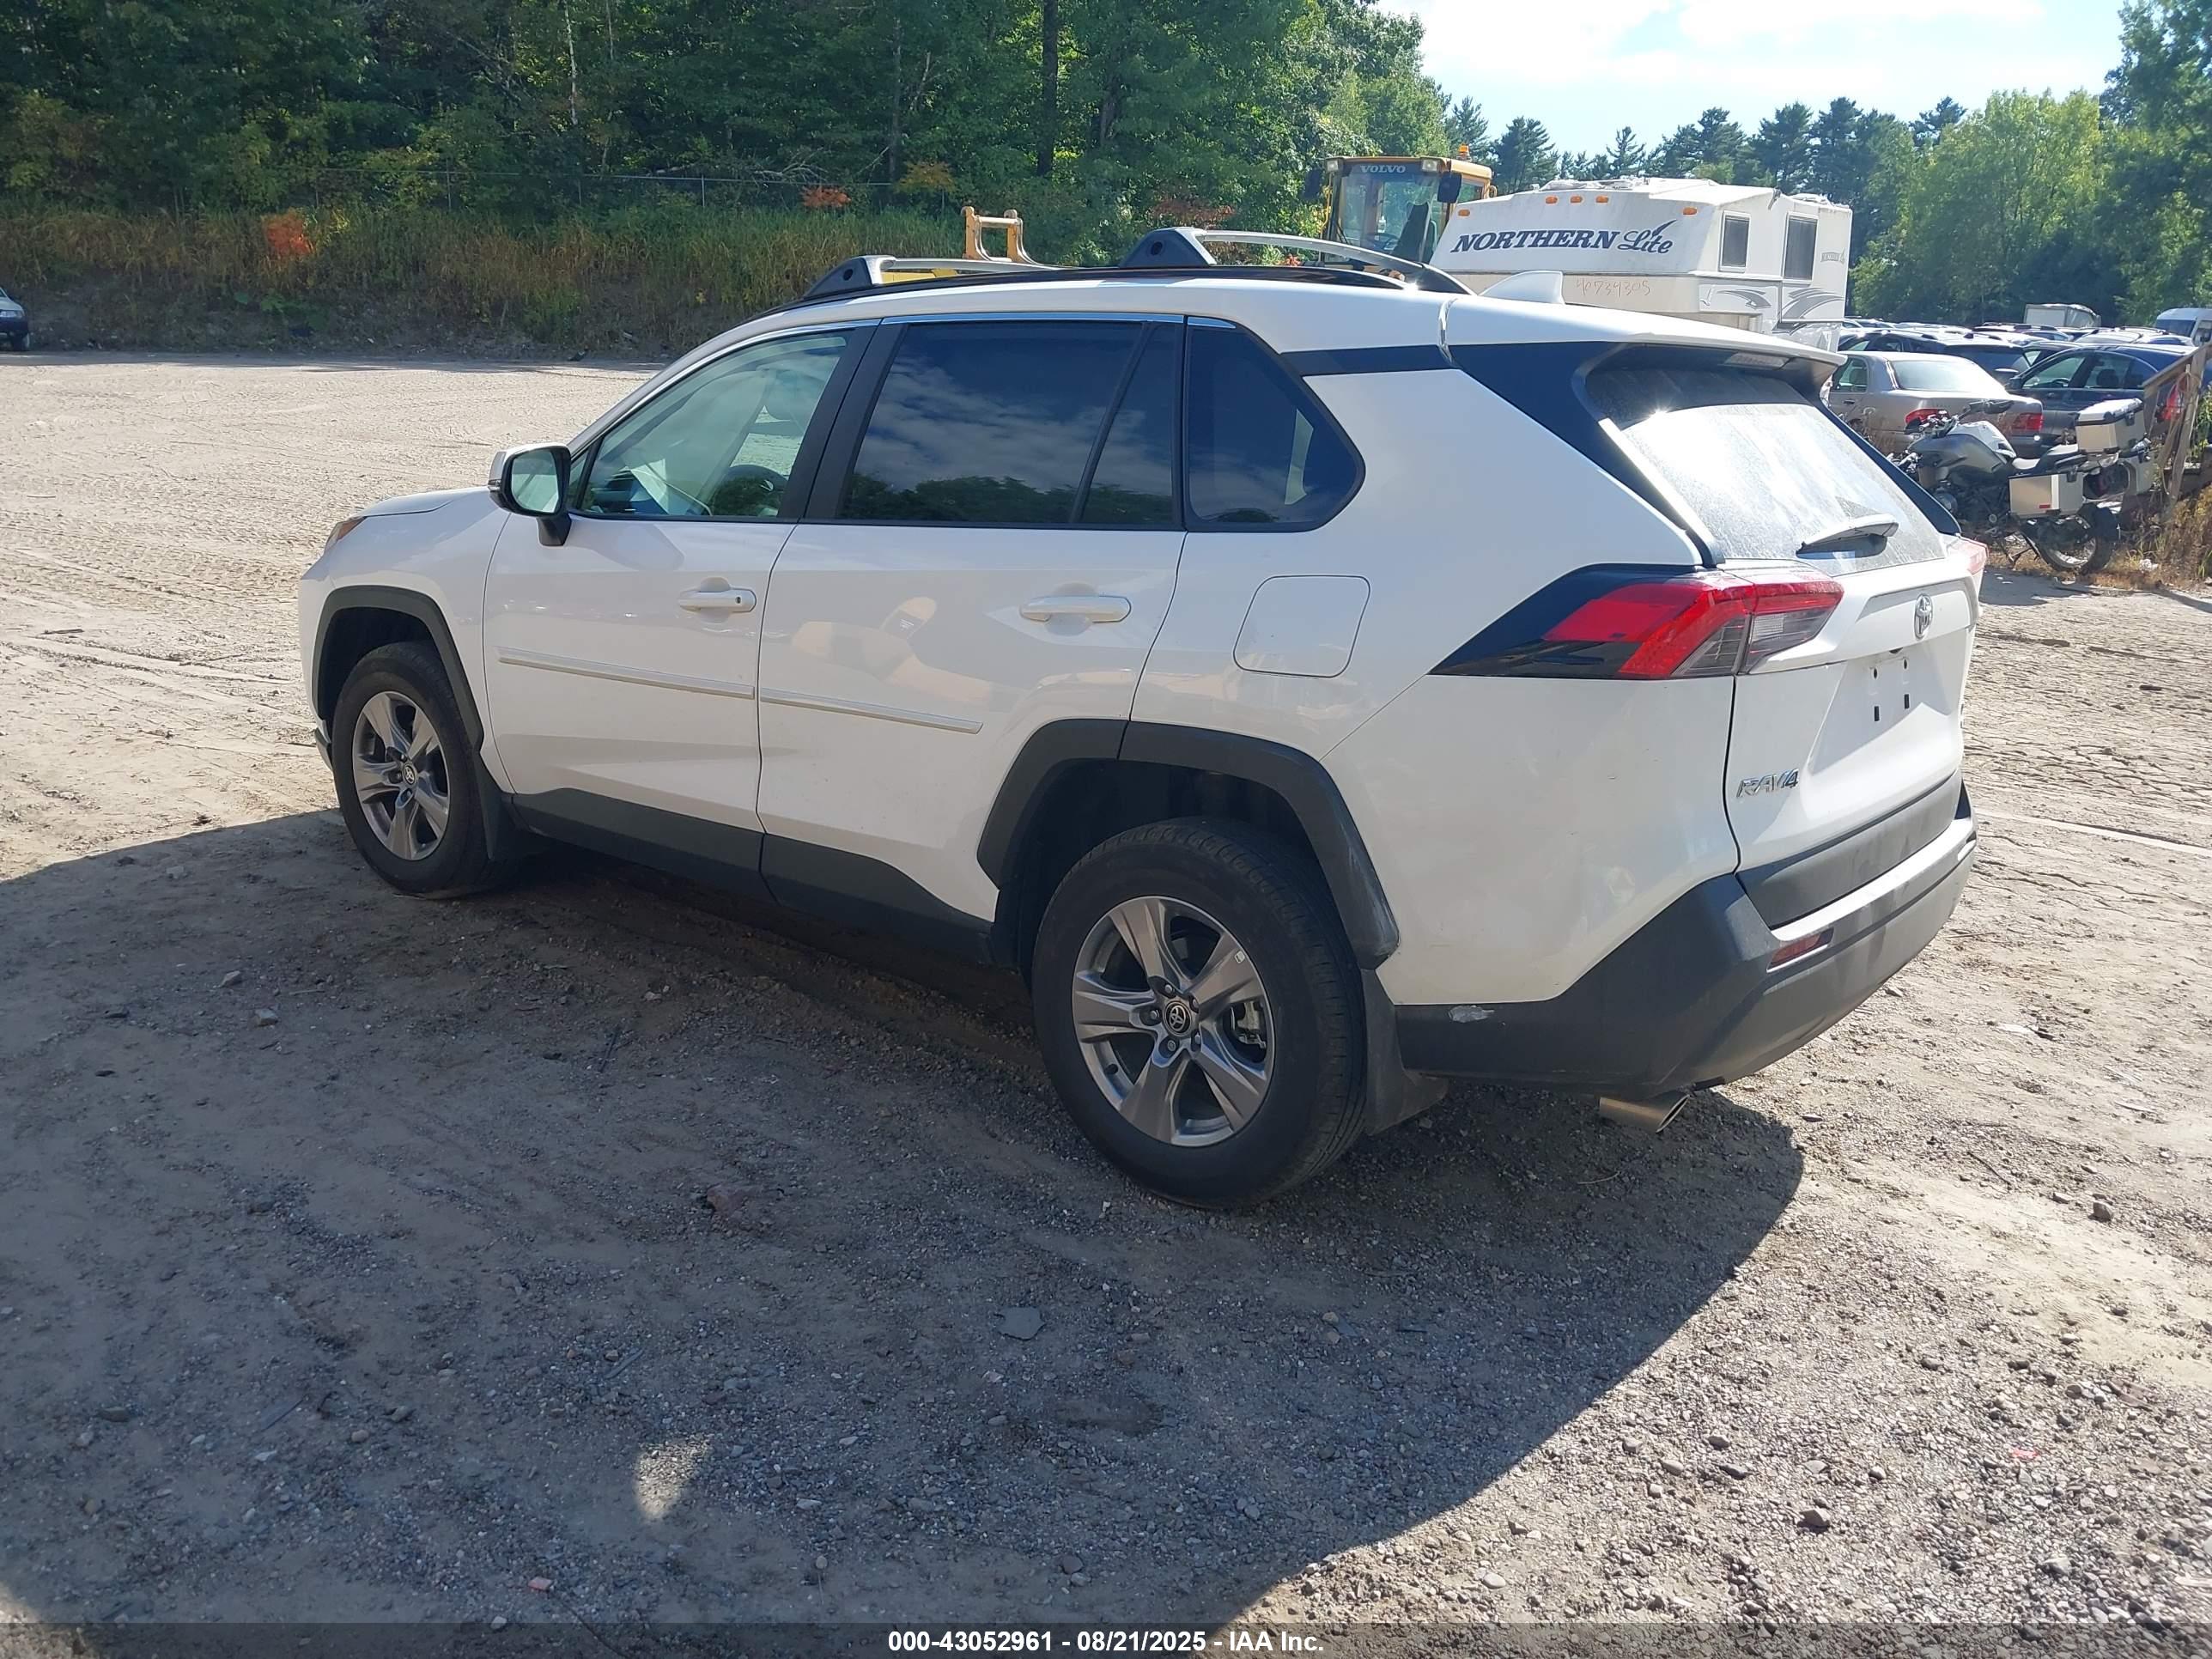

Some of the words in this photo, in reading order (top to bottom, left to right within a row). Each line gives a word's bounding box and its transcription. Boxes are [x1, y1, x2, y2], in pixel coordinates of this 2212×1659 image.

[1450, 230, 1620, 252] NORTHERN
[1617, 219, 1677, 254] Lite
[1735, 768, 1799, 798] RAV4
